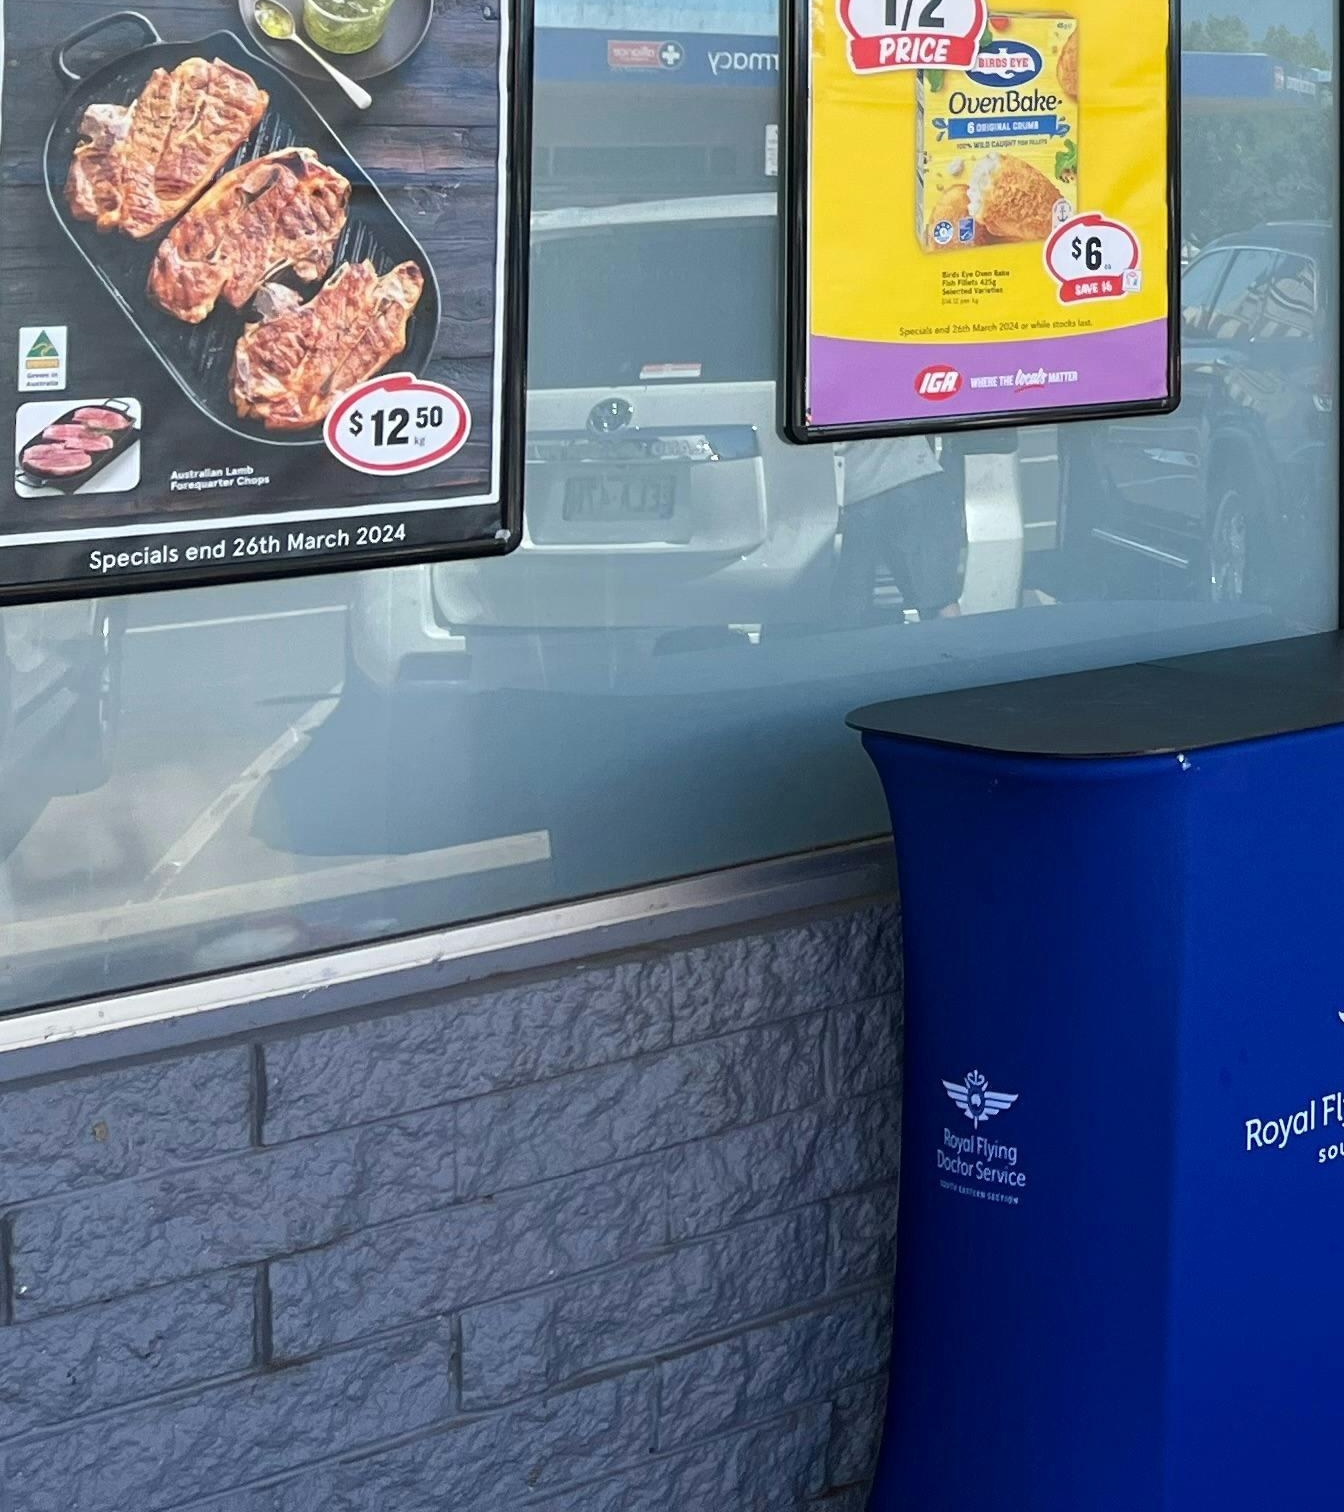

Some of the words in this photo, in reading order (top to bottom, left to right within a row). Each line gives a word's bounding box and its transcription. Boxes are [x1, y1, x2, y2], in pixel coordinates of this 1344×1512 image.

[879, 38, 951, 64] PRICE
[979, 56, 1007, 69] BIRDS
[1010, 56, 1029, 69] EYE
[967, 121, 975, 134] 6
[976, 122, 1011, 133] ORIGINAL
[1013, 120, 1039, 131] CRUMB
[957, 278, 978, 286] Fillets
[961, 271, 973, 280] Eye
[1075, 282, 1098, 296] SAVE
[900, 327, 932, 337] Specials
[935, 326, 950, 334] end
[952, 325, 970, 333] 26th
[973, 324, 997, 332] March
[1000, 322, 1019, 331] 2024
[1031, 321, 1050, 329] while
[1053, 320, 1076, 328] stocks
[919, 371, 959, 394] IGA
[971, 376, 998, 388] WHERE
[999, 374, 1013, 387] THE
[1015, 367, 1048, 386] locals
[1048, 370, 1078, 383] MATTER
[171, 467, 223, 481] Australian
[226, 465, 254, 477] Lamb
[171, 475, 233, 491] Forequarter
[237, 473, 270, 487] Chops
[89, 544, 179, 571] Specials
[186, 539, 225, 560] end
[233, 536, 280, 558] 26th
[287, 527, 350, 552] March
[357, 523, 406, 545] 2024
[1244, 1110, 1317, 1151] Royal
[944, 1127, 974, 1155] Royal
[977, 1136, 1018, 1166] Flying
[937, 1149, 974, 1177] Doctor
[975, 1160, 1026, 1187] Service
